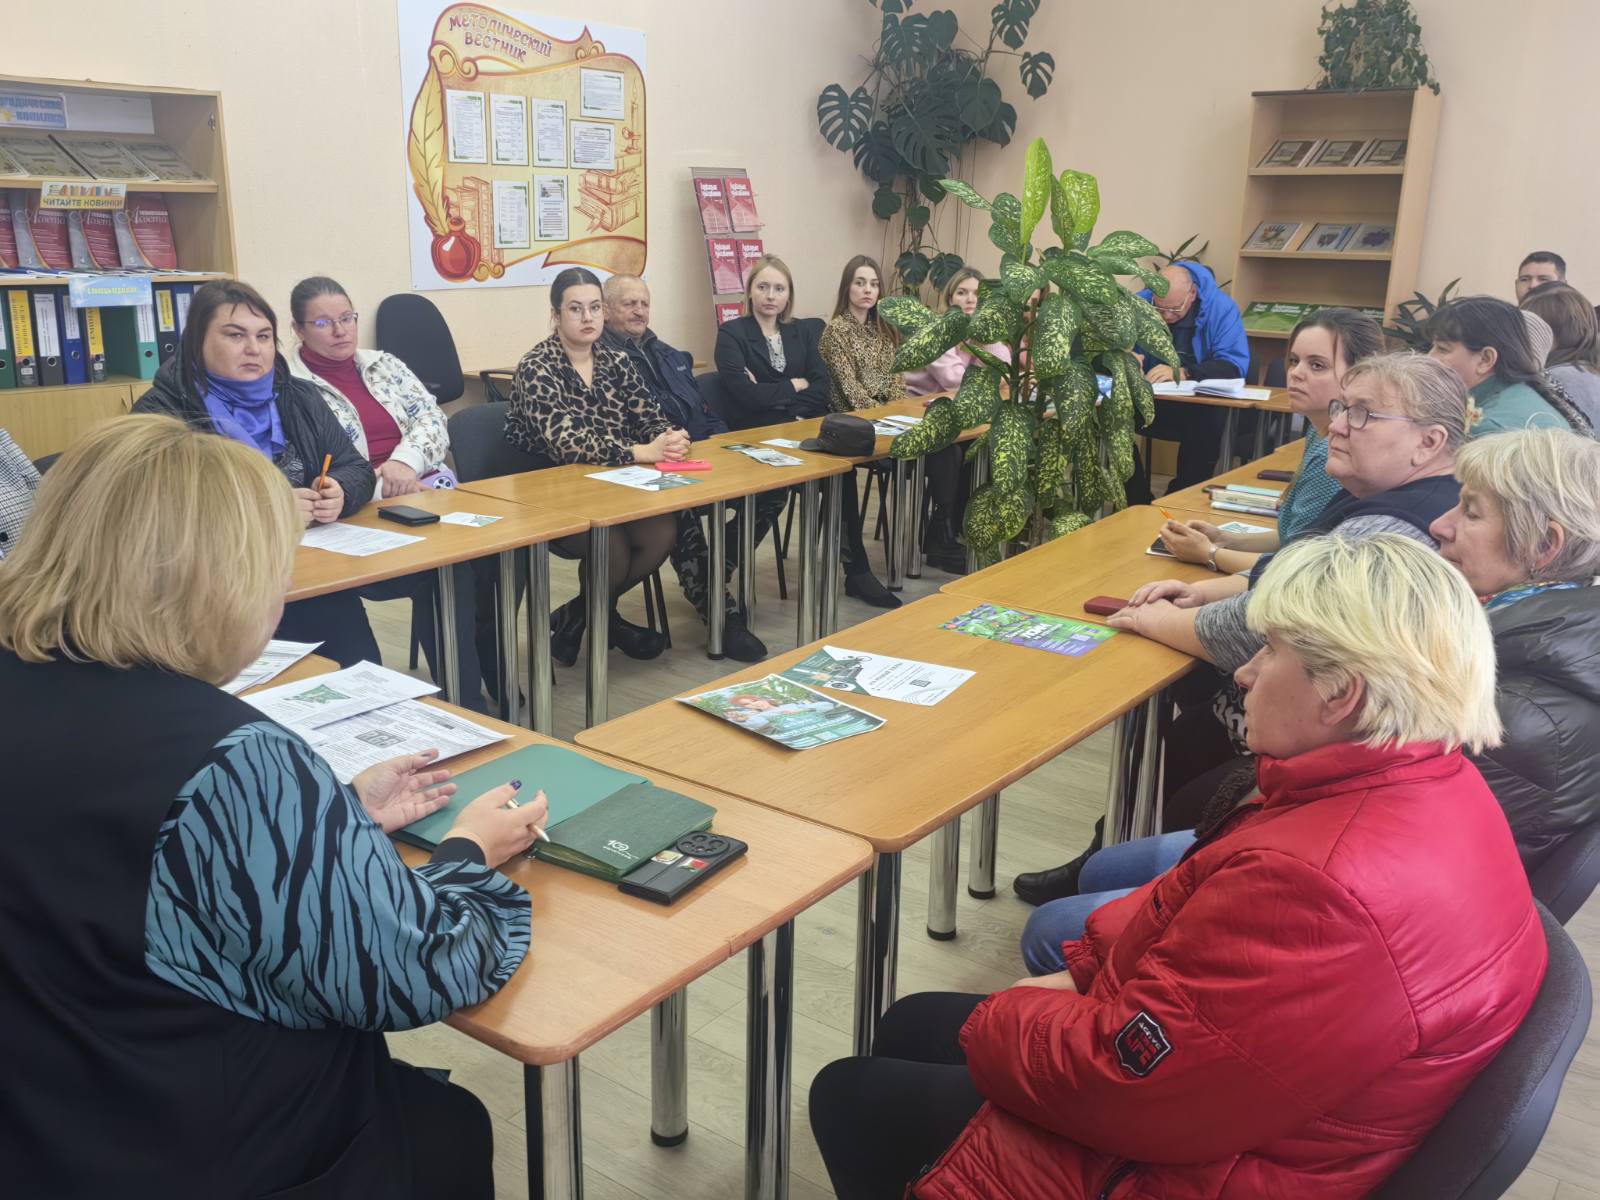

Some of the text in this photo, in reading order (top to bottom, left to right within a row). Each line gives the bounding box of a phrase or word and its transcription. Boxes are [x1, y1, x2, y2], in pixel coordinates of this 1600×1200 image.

[449, 14, 552, 57] МЕТОДИЧЕСКИЙ
[464, 31, 527, 62] ВЕСТНИК
[43, 198, 123, 207] ЧИТАЙТЕ НОВИНКИ
